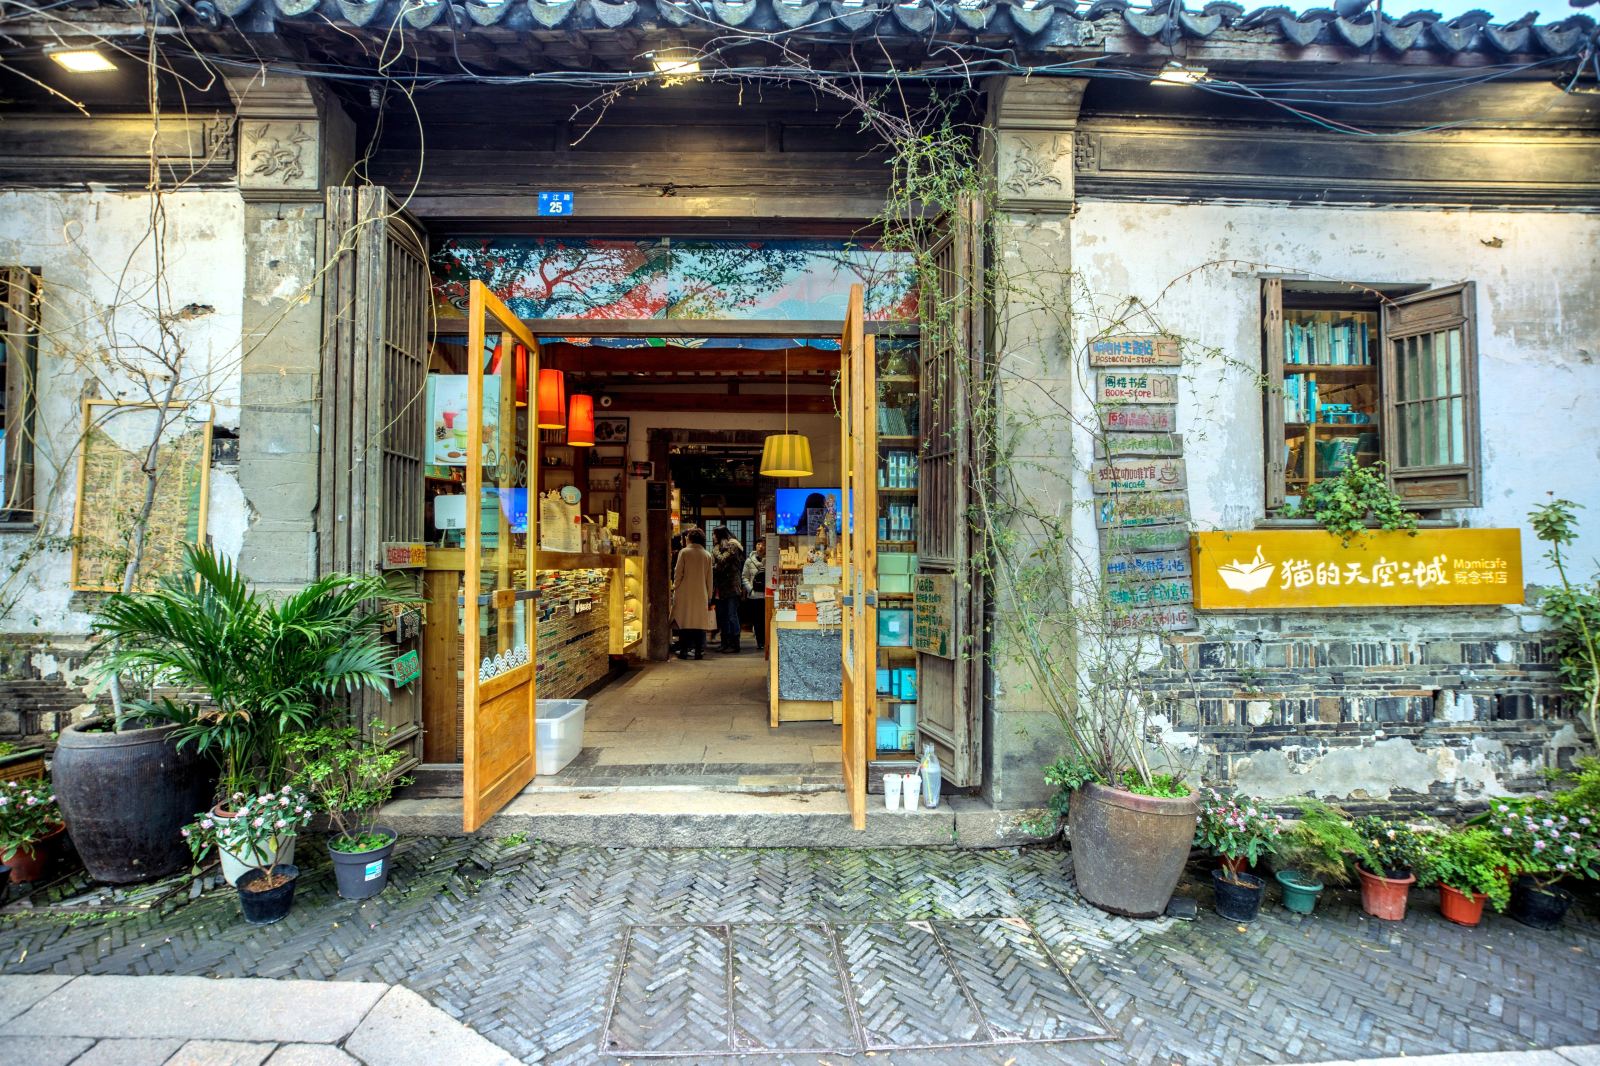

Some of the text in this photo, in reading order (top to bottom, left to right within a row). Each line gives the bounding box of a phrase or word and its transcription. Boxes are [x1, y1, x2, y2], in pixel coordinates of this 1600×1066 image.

[549, 201, 563, 213] 25
[1105, 376, 1148, 388] 阁楼书店
[1453, 558, 1508, 570] Momicafe
[1280, 554, 1451, 589] 猫的天空之城
[1453, 571, 1508, 585] 概念书店
